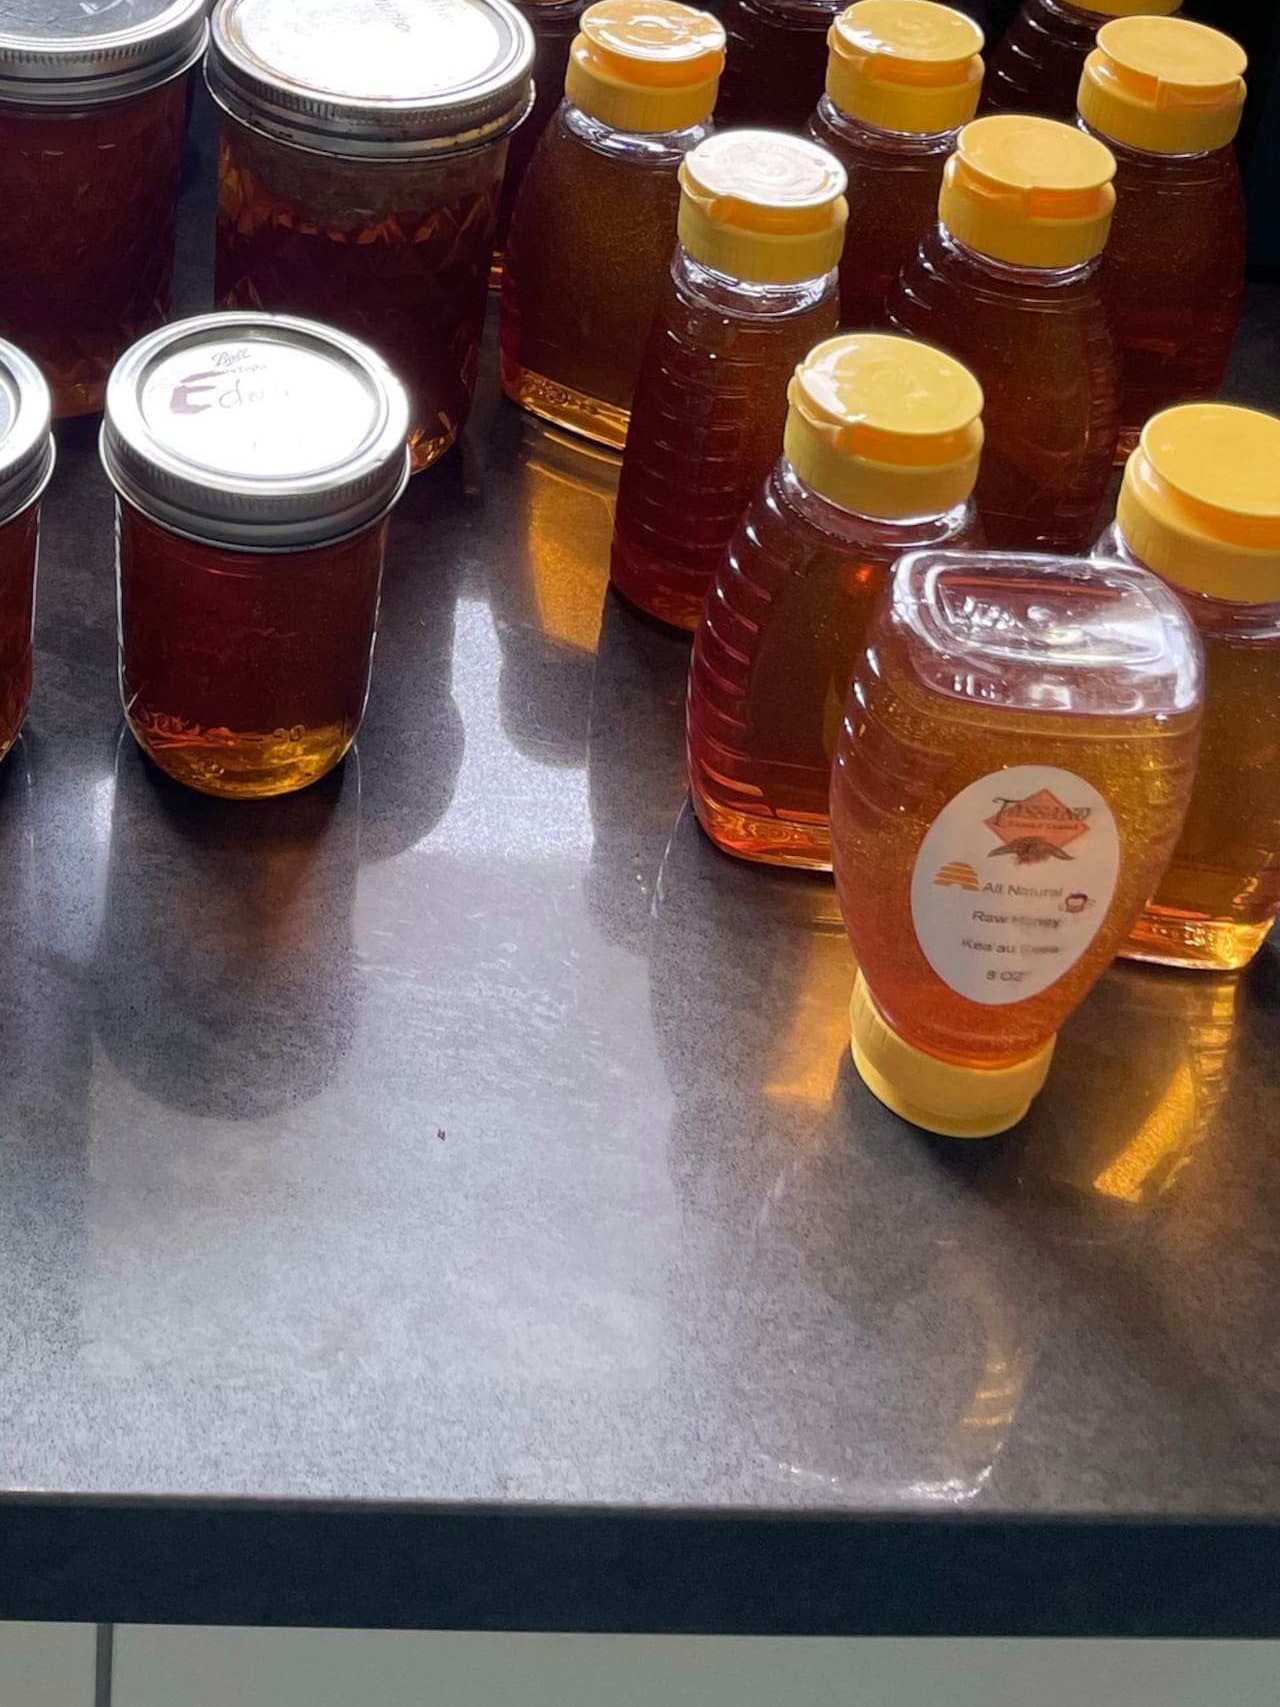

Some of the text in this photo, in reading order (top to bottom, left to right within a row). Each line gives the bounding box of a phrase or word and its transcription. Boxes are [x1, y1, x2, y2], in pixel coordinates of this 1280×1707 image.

[211, 348, 253, 367] Ball
[982, 882, 1063, 897] All Natural
[972, 910, 1009, 924] Raw
